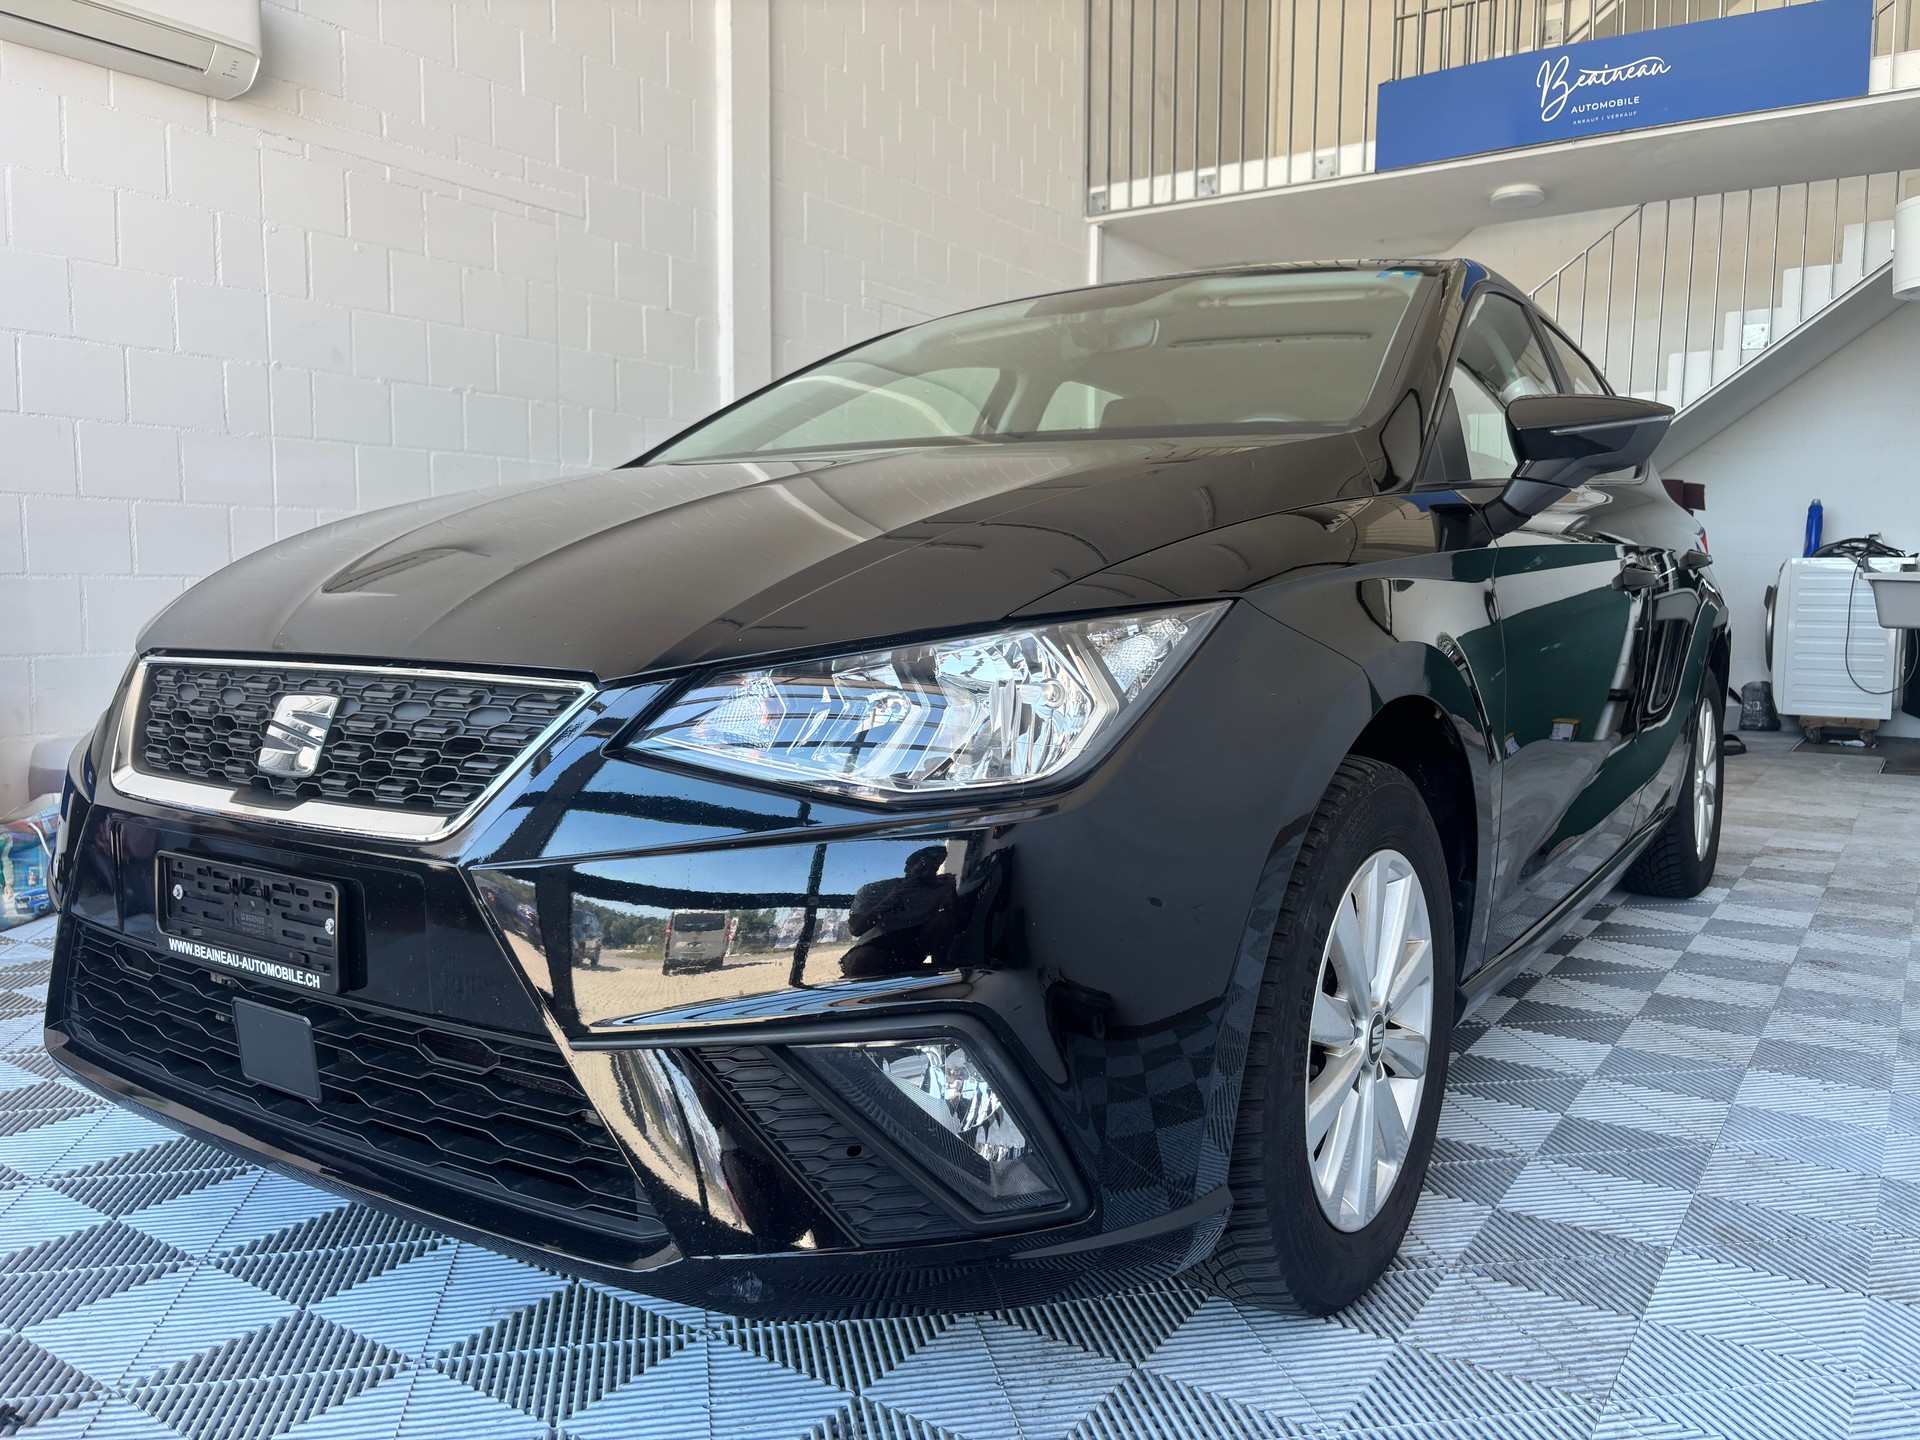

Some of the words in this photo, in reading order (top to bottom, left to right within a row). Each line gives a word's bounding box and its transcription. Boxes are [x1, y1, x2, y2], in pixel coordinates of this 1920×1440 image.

[1571, 95, 1640, 114] AUTOMOBILE
[1572, 116, 1600, 126] ANKAUF
[1606, 110, 1638, 121] VERKAUF
[168, 937, 321, 989] WWW.BEAINEAU-AUTOMOBILE.CH
